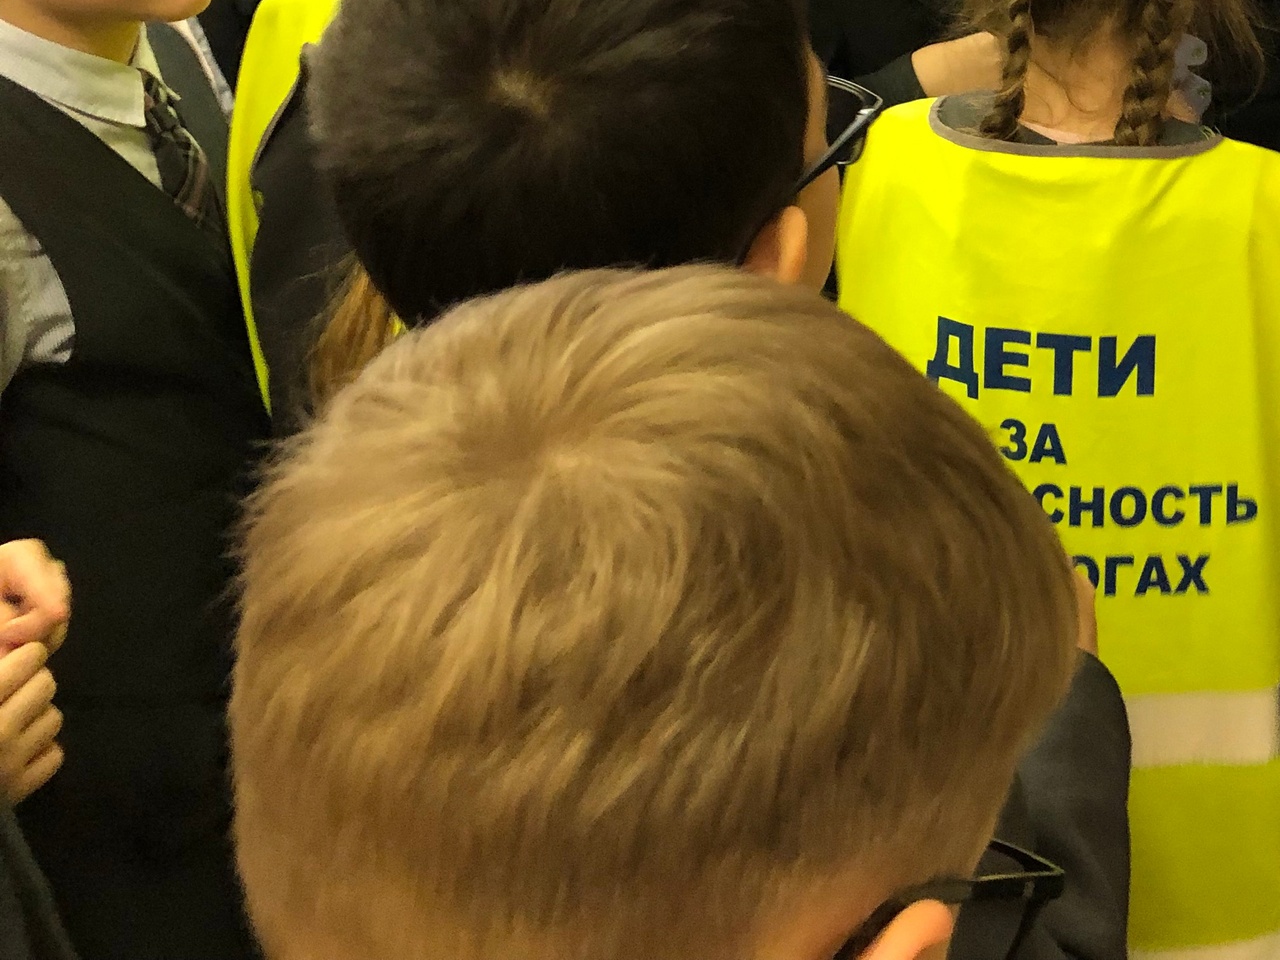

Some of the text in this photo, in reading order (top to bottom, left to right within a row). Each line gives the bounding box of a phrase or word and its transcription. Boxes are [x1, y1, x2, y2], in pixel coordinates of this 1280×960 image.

[926, 315, 1157, 400] ДЕТИ
[1000, 418, 1067, 465] ЗА
[1033, 481, 1259, 528] СНОСТЬ
[1070, 553, 1211, 596] ОГАХ
